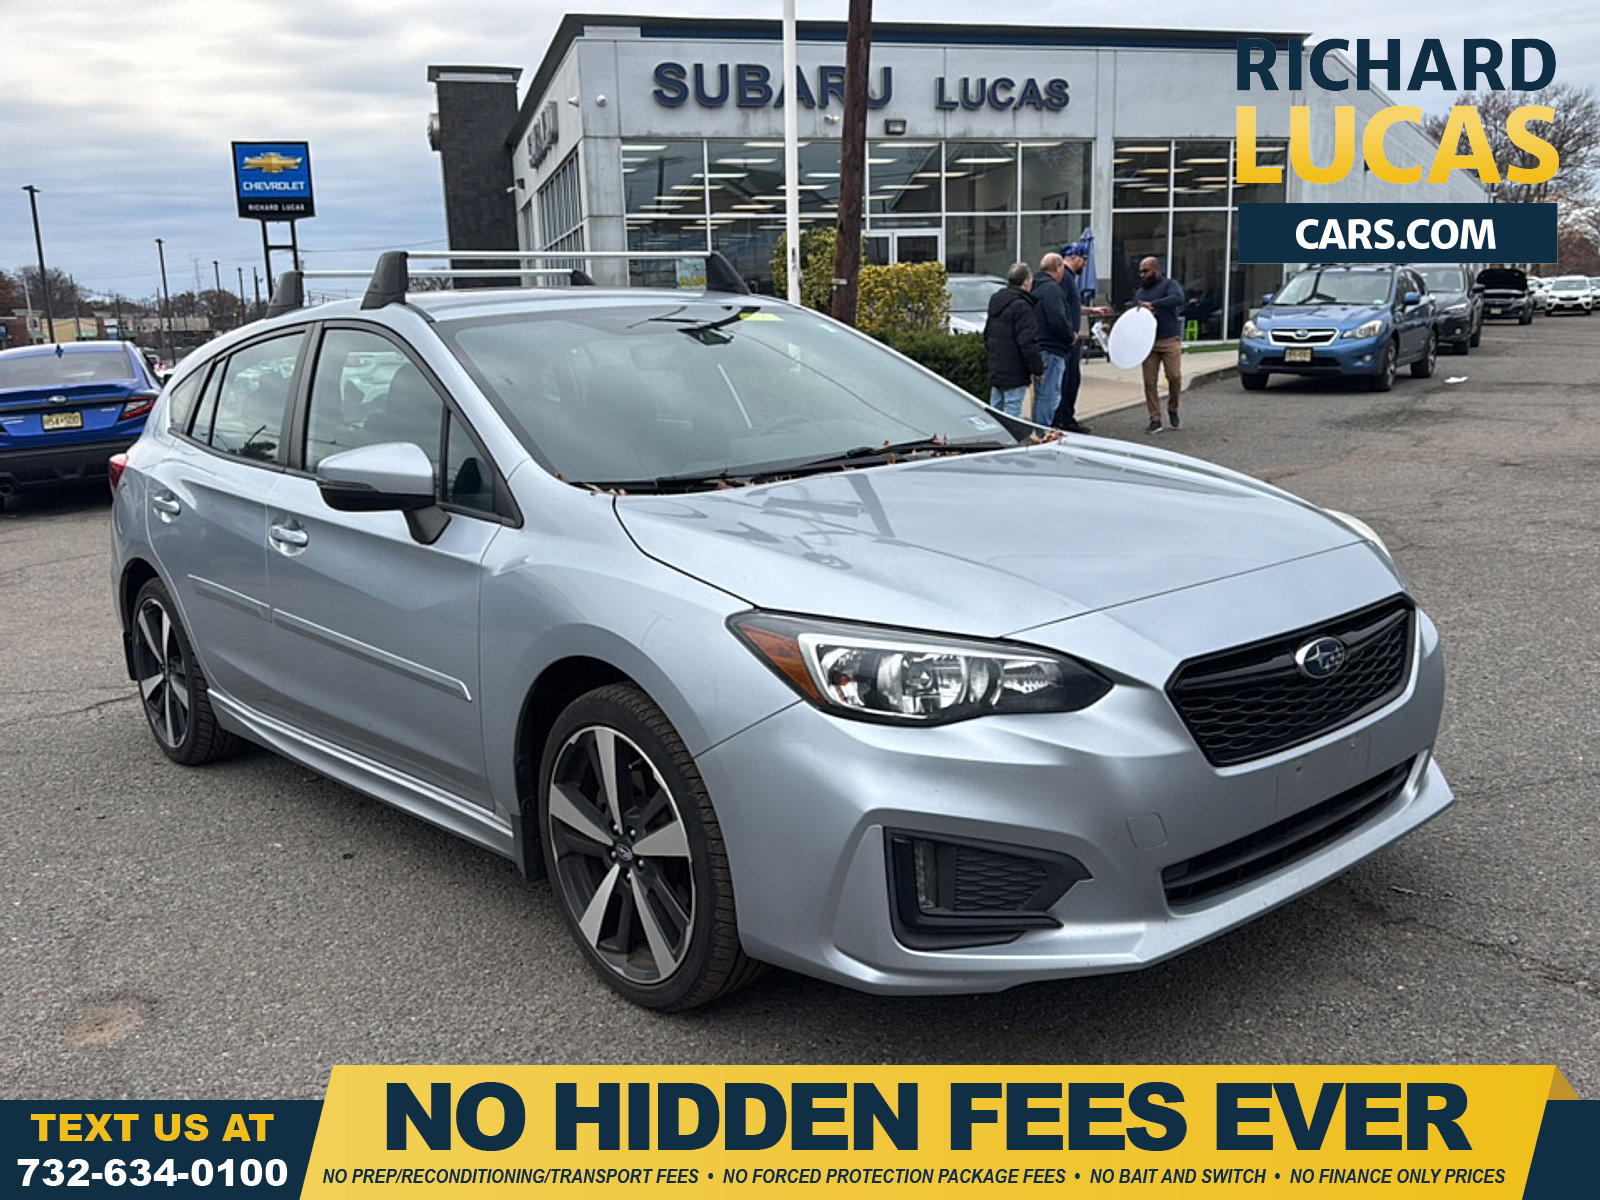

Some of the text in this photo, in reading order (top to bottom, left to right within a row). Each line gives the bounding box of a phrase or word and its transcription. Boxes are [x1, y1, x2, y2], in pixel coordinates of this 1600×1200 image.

[936, 76, 1070, 111] LUCAS
[243, 181, 305, 191] CHEVROLET
[282, 203, 305, 211] LUCAS
